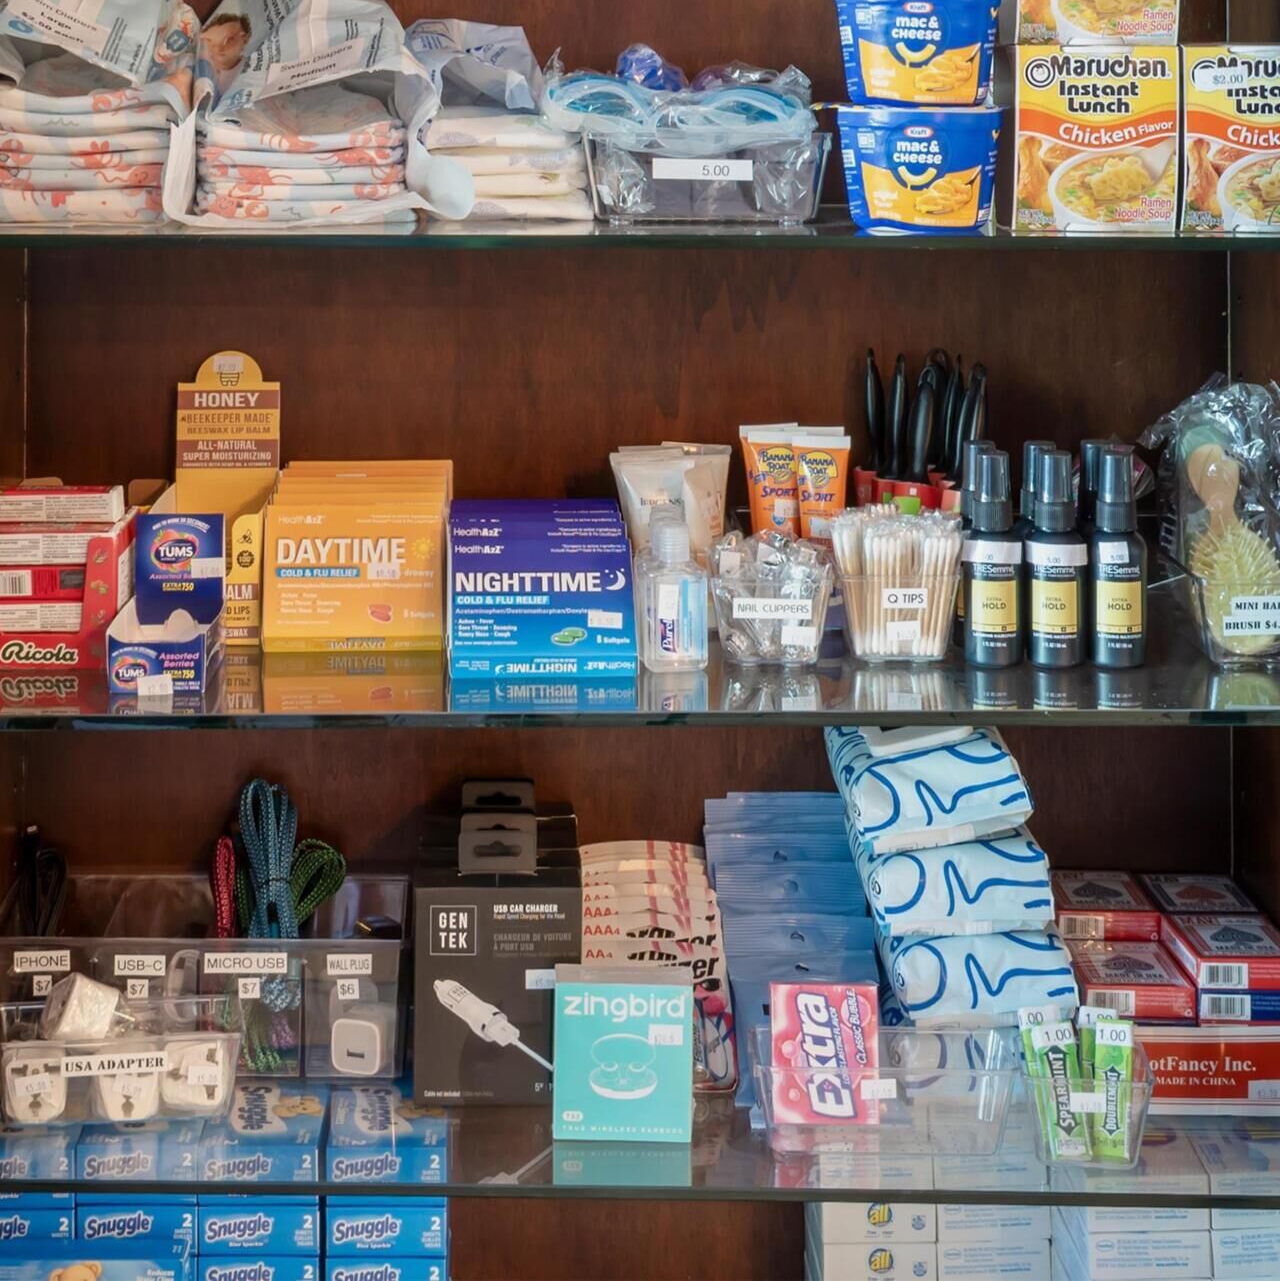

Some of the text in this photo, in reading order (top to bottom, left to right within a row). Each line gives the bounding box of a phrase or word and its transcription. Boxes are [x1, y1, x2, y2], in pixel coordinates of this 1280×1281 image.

[1143, 9, 1173, 20] Ramen
[896, 15, 939, 29] mac &
[1117, 20, 1173, 34] Noodle Soup
[1050, 54, 1166, 78] Maruchan
[1212, 74, 1243, 86] $2.00
[1059, 81, 1139, 99] Instant
[1069, 98, 1130, 114] Lunch
[1059, 119, 1174, 145] Chicken Flavor
[896, 140, 940, 153] mac &
[702, 165, 730, 176] 5.00
[1115, 208, 1171, 221] Noodle Soup
[194, 392, 260, 408] HONEY
[187, 413, 272, 424] BEEKEEPER MADE
[187, 426, 271, 434] BEESWAX LIP BALM
[197, 440, 257, 450] ALL-NATURAL
[183, 451, 271, 461] SUPER MOISTURIZING
[767, 462, 791, 473] BOAT
[761, 486, 797, 497] SPORT
[159, 546, 193, 558] TUMS
[276, 538, 407, 564] DAYTIME
[280, 568, 358, 577] COLD & FLU RELIEF
[455, 572, 602, 593] NIGHTTIME
[888, 593, 924, 605] Q TIPS
[737, 604, 809, 614] NAIL CLIPPERS
[982, 602, 1007, 610] HOLD
[1234, 601, 1259, 612] MINI
[1224, 621, 1261, 632] BRUSH
[0, 641, 78, 664] Ricola
[159, 652, 200, 661] Assorted
[163, 660, 194, 668] Berries
[182, 670, 195, 679] 750
[494, 904, 558, 913] USB CAR CHARGER
[439, 912, 468, 929] GEN
[439, 932, 468, 949] TEK
[16, 955, 69, 968] IPHONE
[117, 959, 163, 971] USB-C
[206, 957, 285, 970] MICRO USB
[329, 958, 371, 970] WALL PLUG
[35, 979, 51, 992] $7
[130, 983, 145, 996] $7
[339, 982, 354, 995] $6
[564, 992, 686, 1022] zingbird
[852, 1027, 867, 1064] CLASSIC
[797, 992, 857, 1118] Extra
[65, 1057, 164, 1072] USA ADAPTER
[1150, 1055, 1257, 1075] otFancy Inc.
[1156, 1077, 1236, 1086] MADE IN CHINA
[1048, 1052, 1075, 1127] SPEARMINT
[85, 1153, 151, 1177] Snuggle
[870, 1203, 890, 1224] all
[871, 1250, 891, 1271] all
